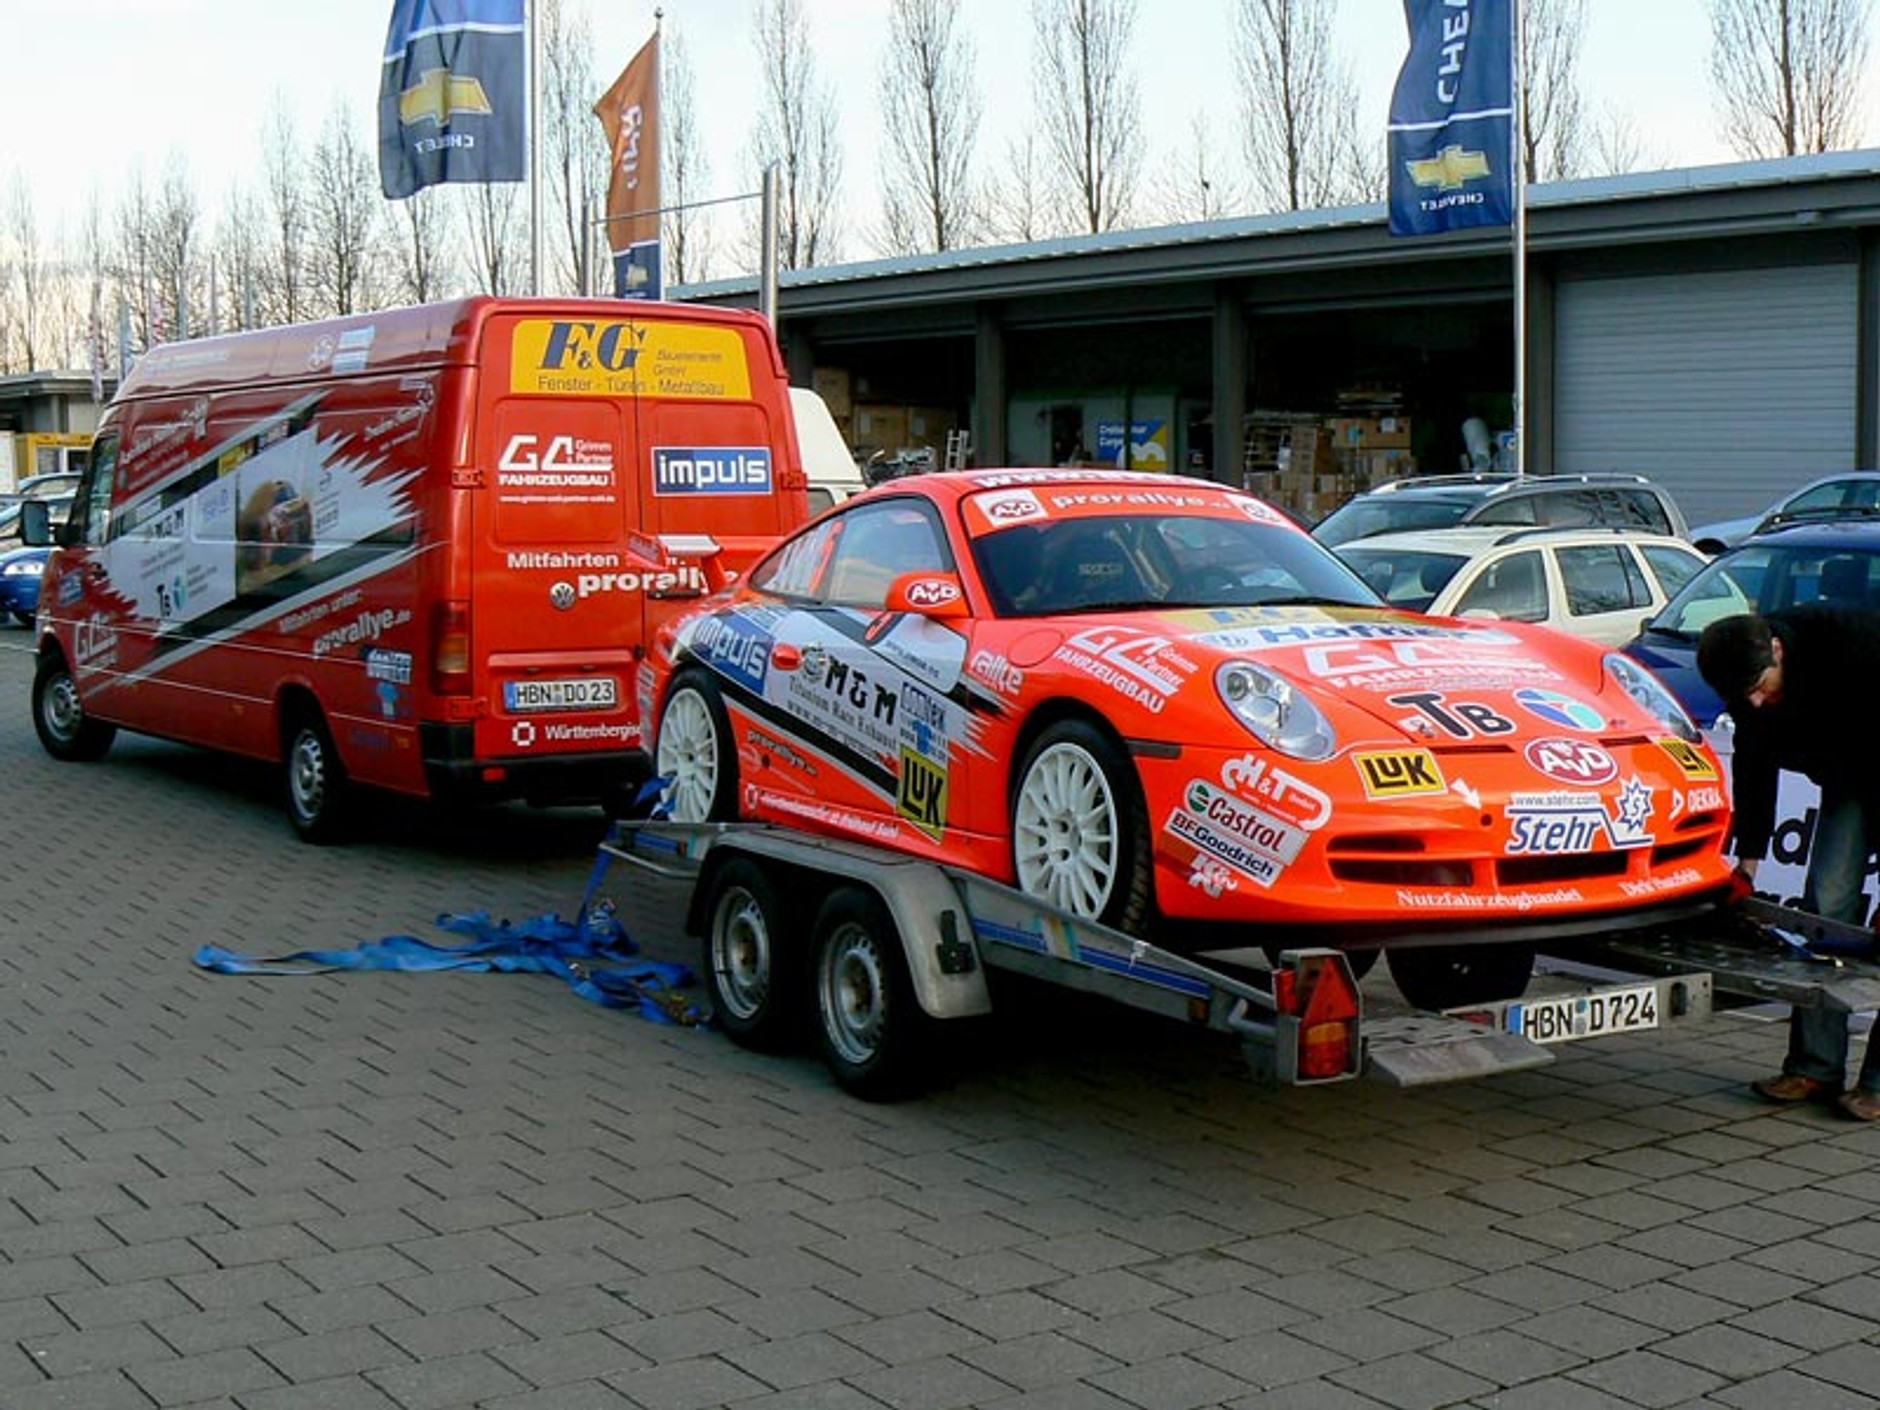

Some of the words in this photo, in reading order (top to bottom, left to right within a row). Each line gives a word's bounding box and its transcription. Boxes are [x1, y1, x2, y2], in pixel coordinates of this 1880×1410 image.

[537, 374, 592, 391] Fenster
[499, 474, 609, 487] FAHRZEUGBAU
[659, 455, 768, 489] impuls
[507, 552, 619, 568] Mitfahrten
[516, 684, 551, 704] HBN
[590, 681, 613, 700] 23
[1053, 645, 1165, 714] FAHRZEUGBAU
[1538, 747, 1612, 778] AvD
[1207, 796, 1286, 853] Castrol
[1507, 814, 1602, 851] Stehr
[1171, 811, 1273, 877] BFGoodrich
[1524, 1003, 1573, 1039] HBN
[1588, 998, 1605, 1031] D
[1608, 991, 1656, 1028] 724
